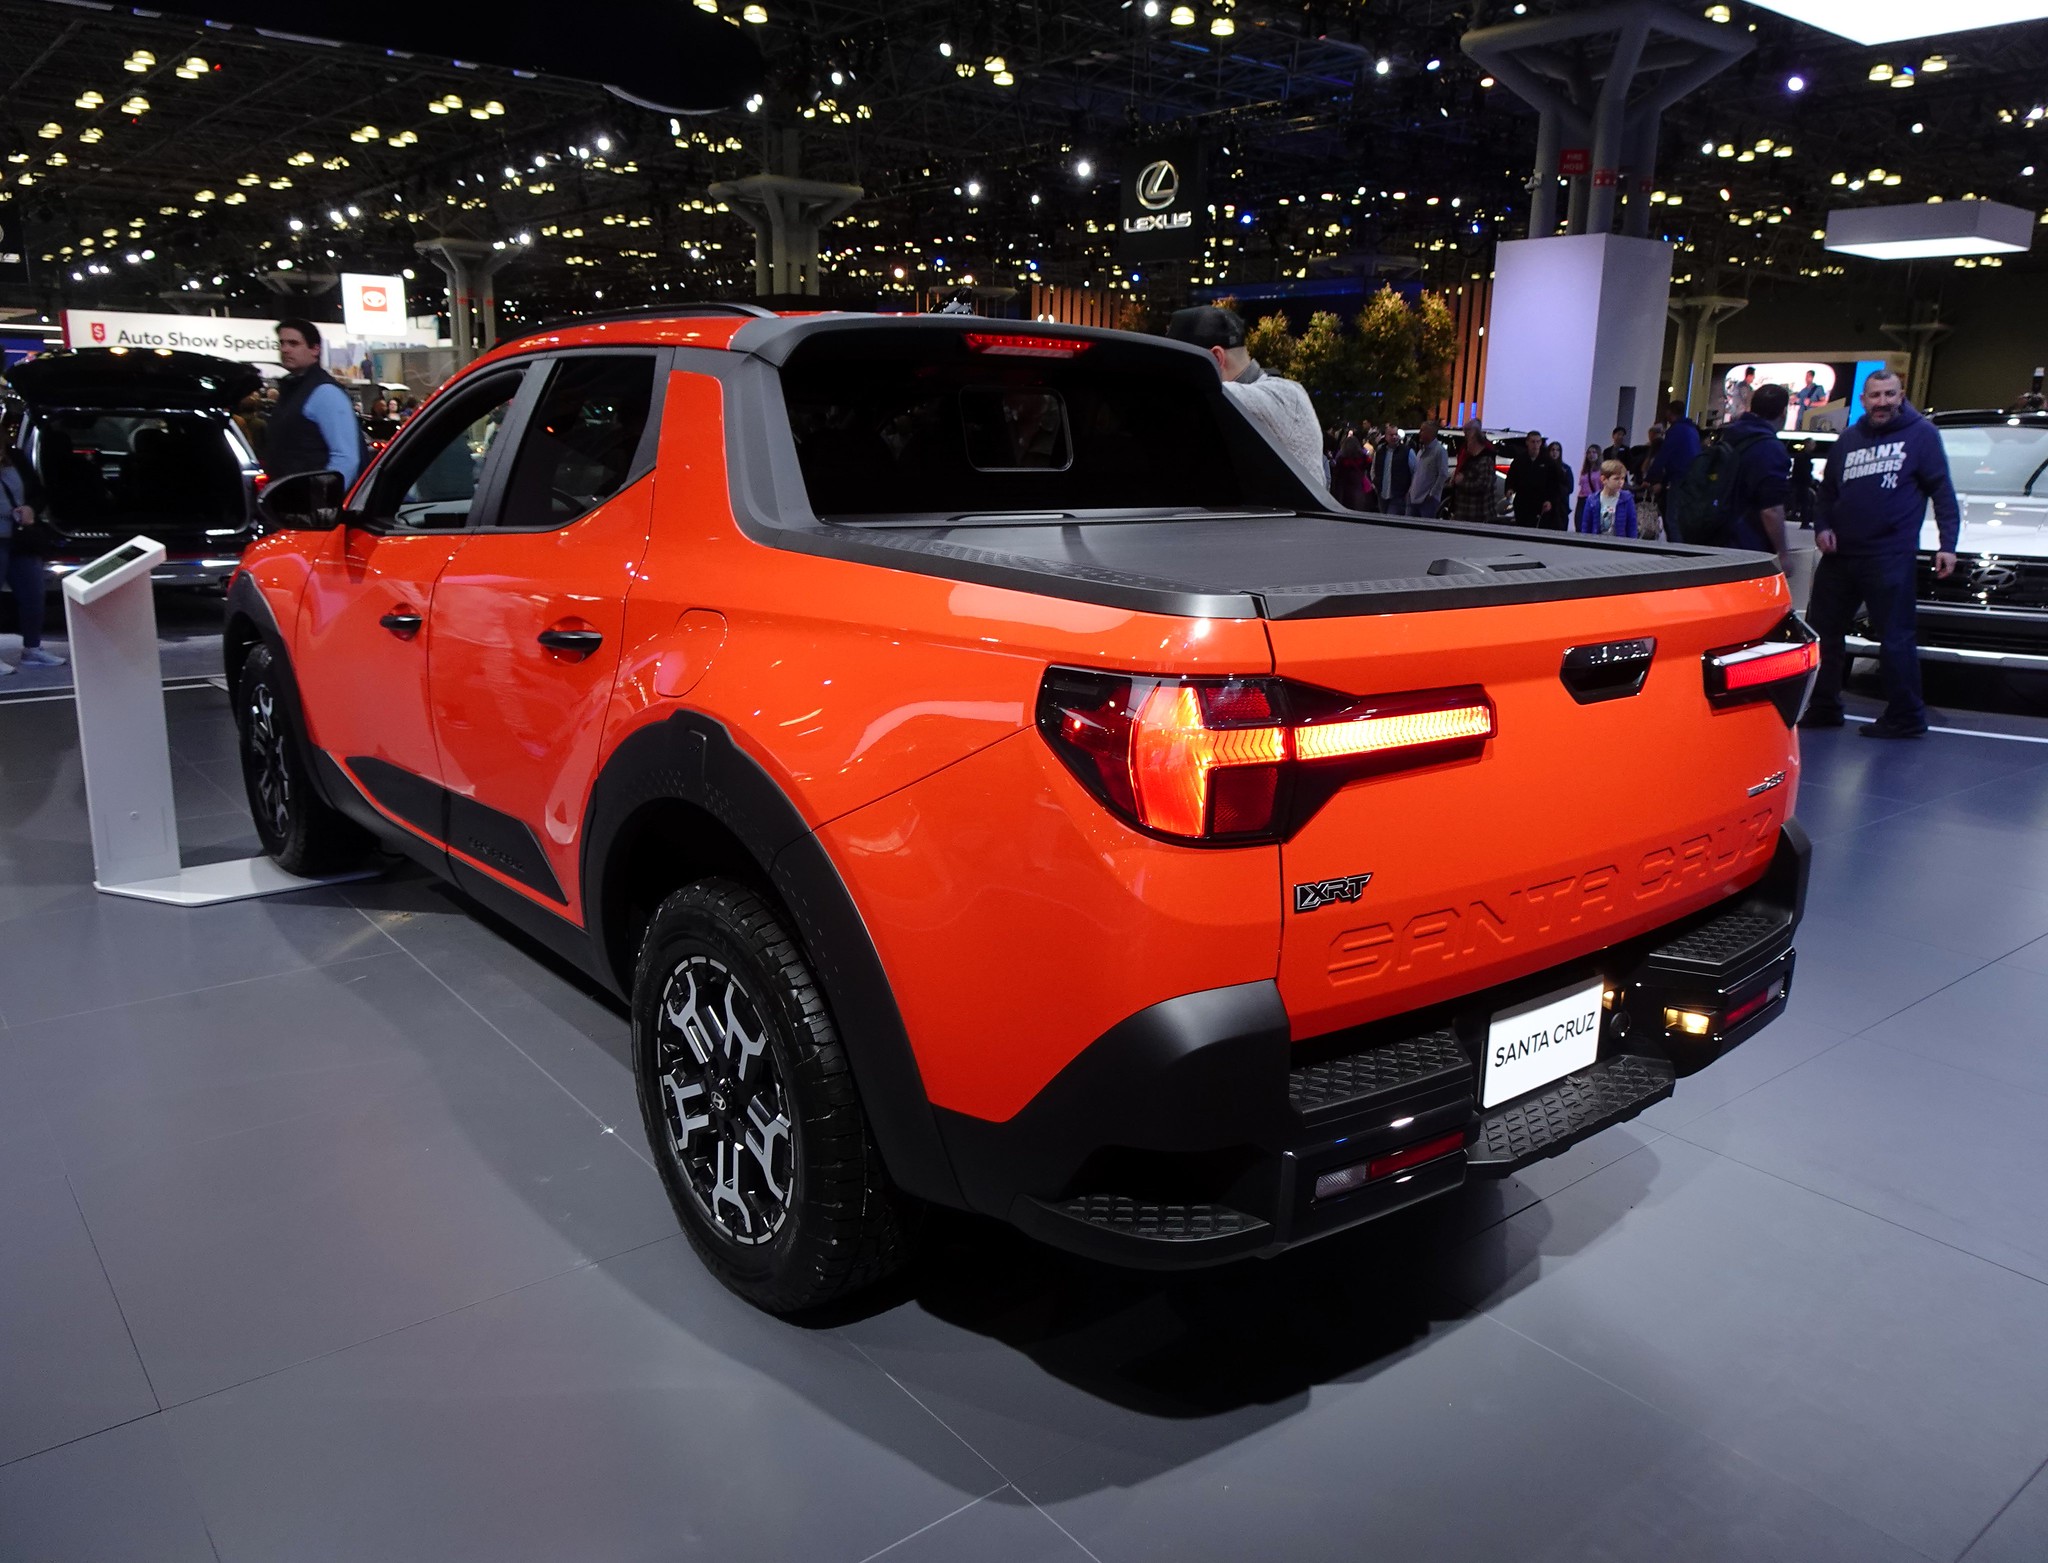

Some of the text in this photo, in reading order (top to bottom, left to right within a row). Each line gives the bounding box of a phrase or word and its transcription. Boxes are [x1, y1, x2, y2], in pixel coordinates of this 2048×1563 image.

[1123, 211, 1192, 233] LEXUS
[118, 330, 163, 345] Auto
[168, 332, 218, 348] Show
[1842, 459, 1903, 482] BOMBERS
[1327, 807, 1774, 987] SANTA CRUZ
[1494, 1011, 1596, 1068] SANTA CRUZ
